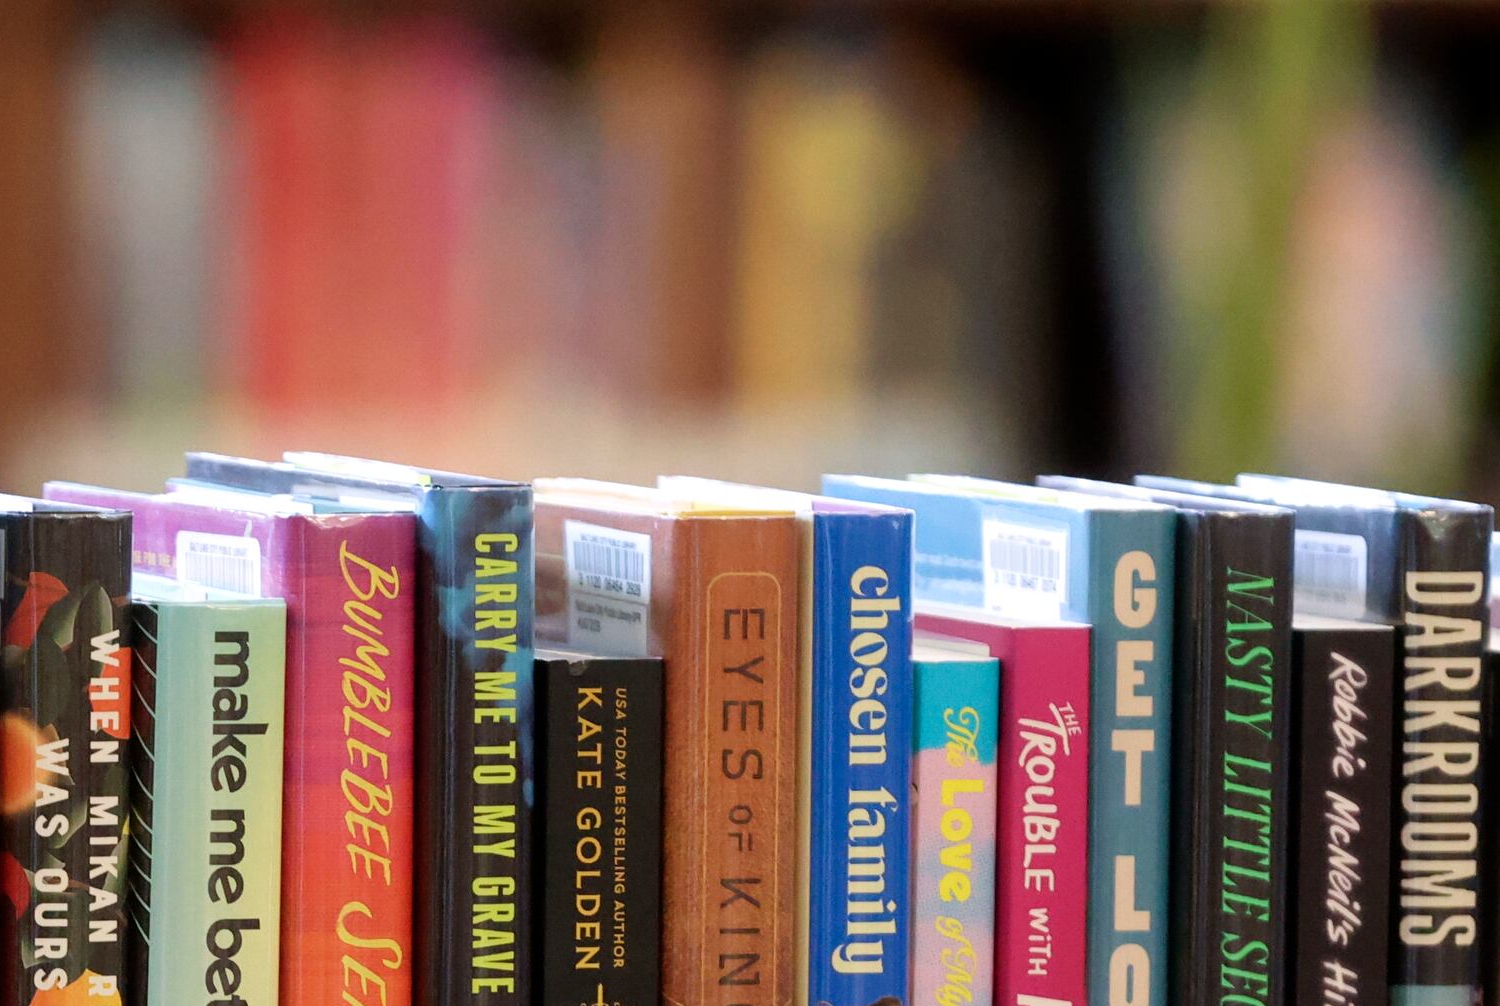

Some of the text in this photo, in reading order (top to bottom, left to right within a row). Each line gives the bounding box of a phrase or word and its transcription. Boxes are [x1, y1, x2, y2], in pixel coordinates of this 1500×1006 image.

[89, 629, 120, 764] WHEN
[211, 630, 269, 793] make
[338, 540, 399, 886] BUMBLEBEE
[721, 609, 766, 780] EYES
[943, 706, 980, 769] The
[1056, 701, 1082, 737] THE
[1111, 550, 1158, 806] GET
[1224, 566, 1275, 741] NASTY
[1327, 651, 1368, 778] Robbie
[471, 532, 518, 995] CARRY ME TO MY GRAVE
[574, 687, 603, 971] KATE GOLDEN
[612, 687, 628, 968] USA TODAY BESTSELLING AUTHOR
[831, 565, 901, 975] chosen family
[939, 779, 985, 903] Love
[1018, 702, 1070, 893] TROUBLE
[1222, 752, 1273, 922] LITTLE
[1400, 570, 1483, 947] DARKROOMS
[34, 738, 69, 992] WAS OURS
[89, 796, 119, 942] MIKAN
[208, 808, 246, 905] me
